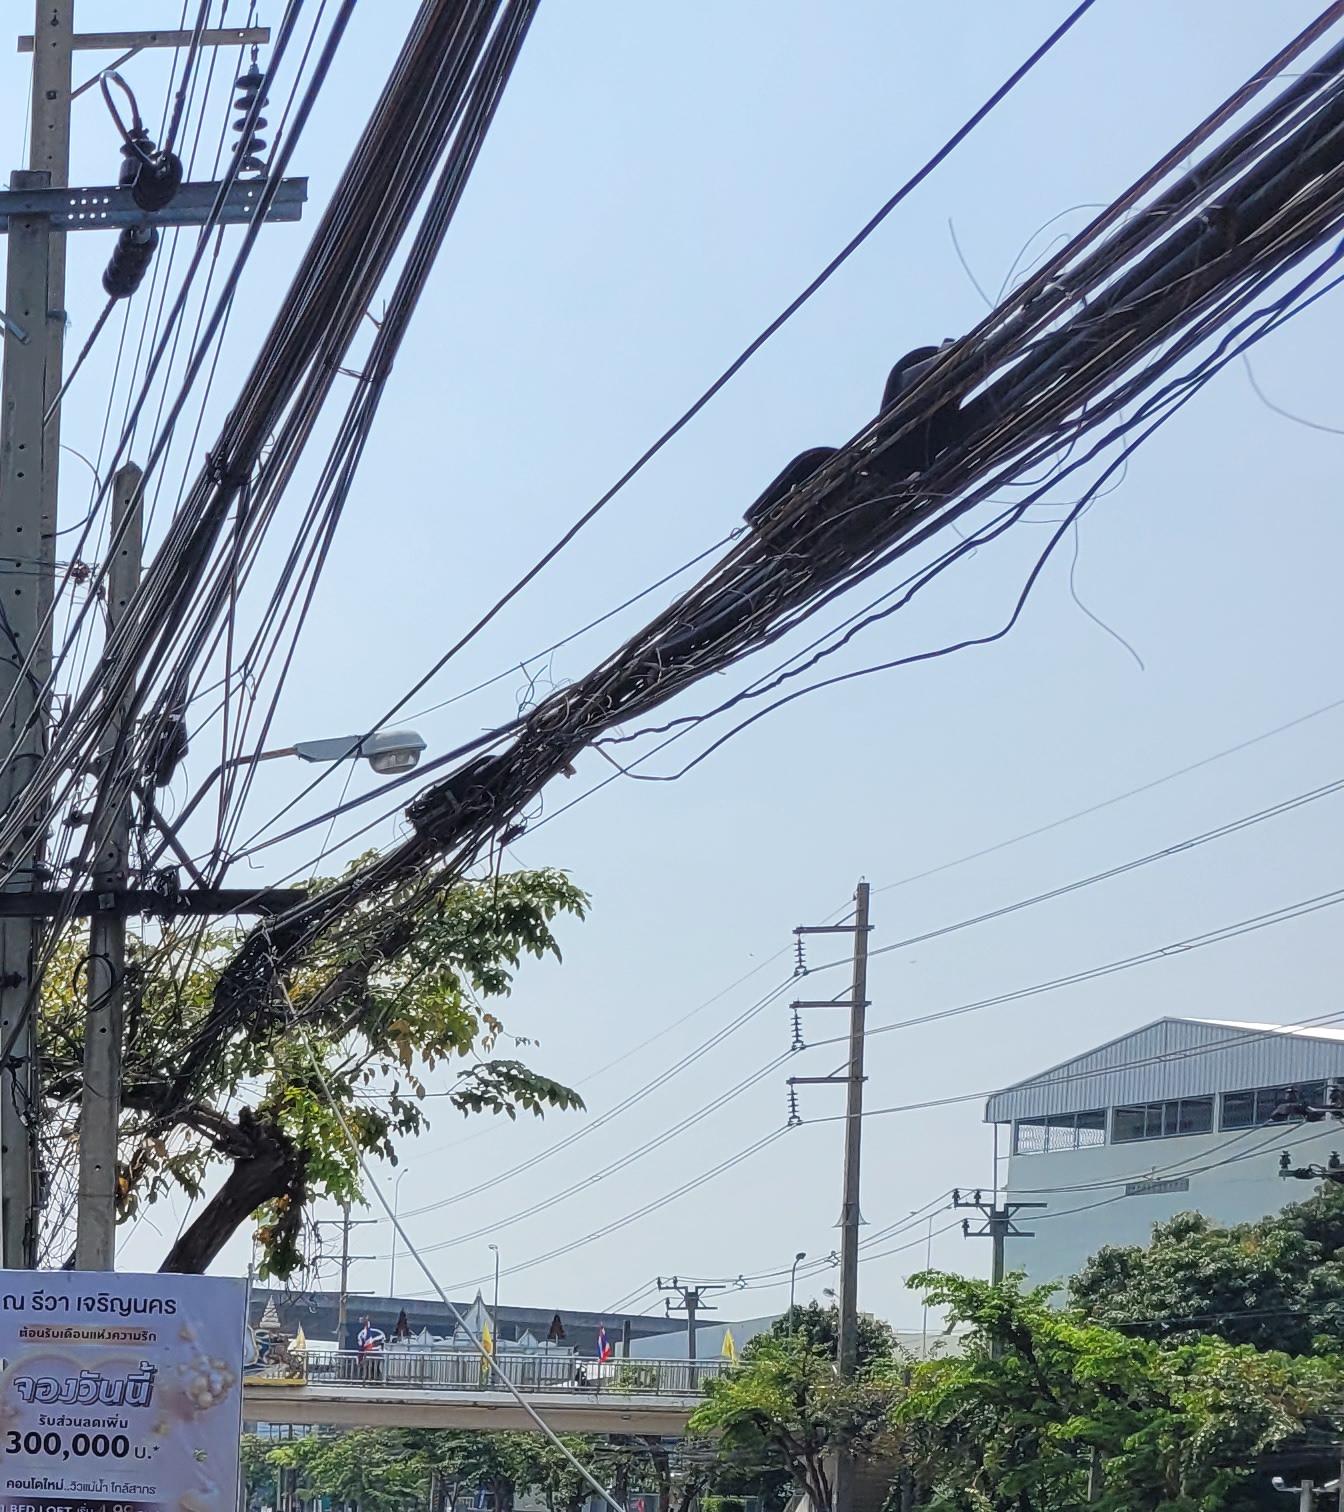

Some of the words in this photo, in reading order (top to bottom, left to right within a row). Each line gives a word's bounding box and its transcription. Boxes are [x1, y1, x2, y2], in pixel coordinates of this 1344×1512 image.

[2, 1294, 25, 1311] ณ
[31, 1289, 70, 1312] รีวา
[76, 1292, 177, 1317] เจริญนคร
[13, 1361, 158, 1408] จองวันนี้
[38, 1413, 129, 1429] รับส่วนลดเพิ่ม
[5, 1430, 130, 1461] 300,000
